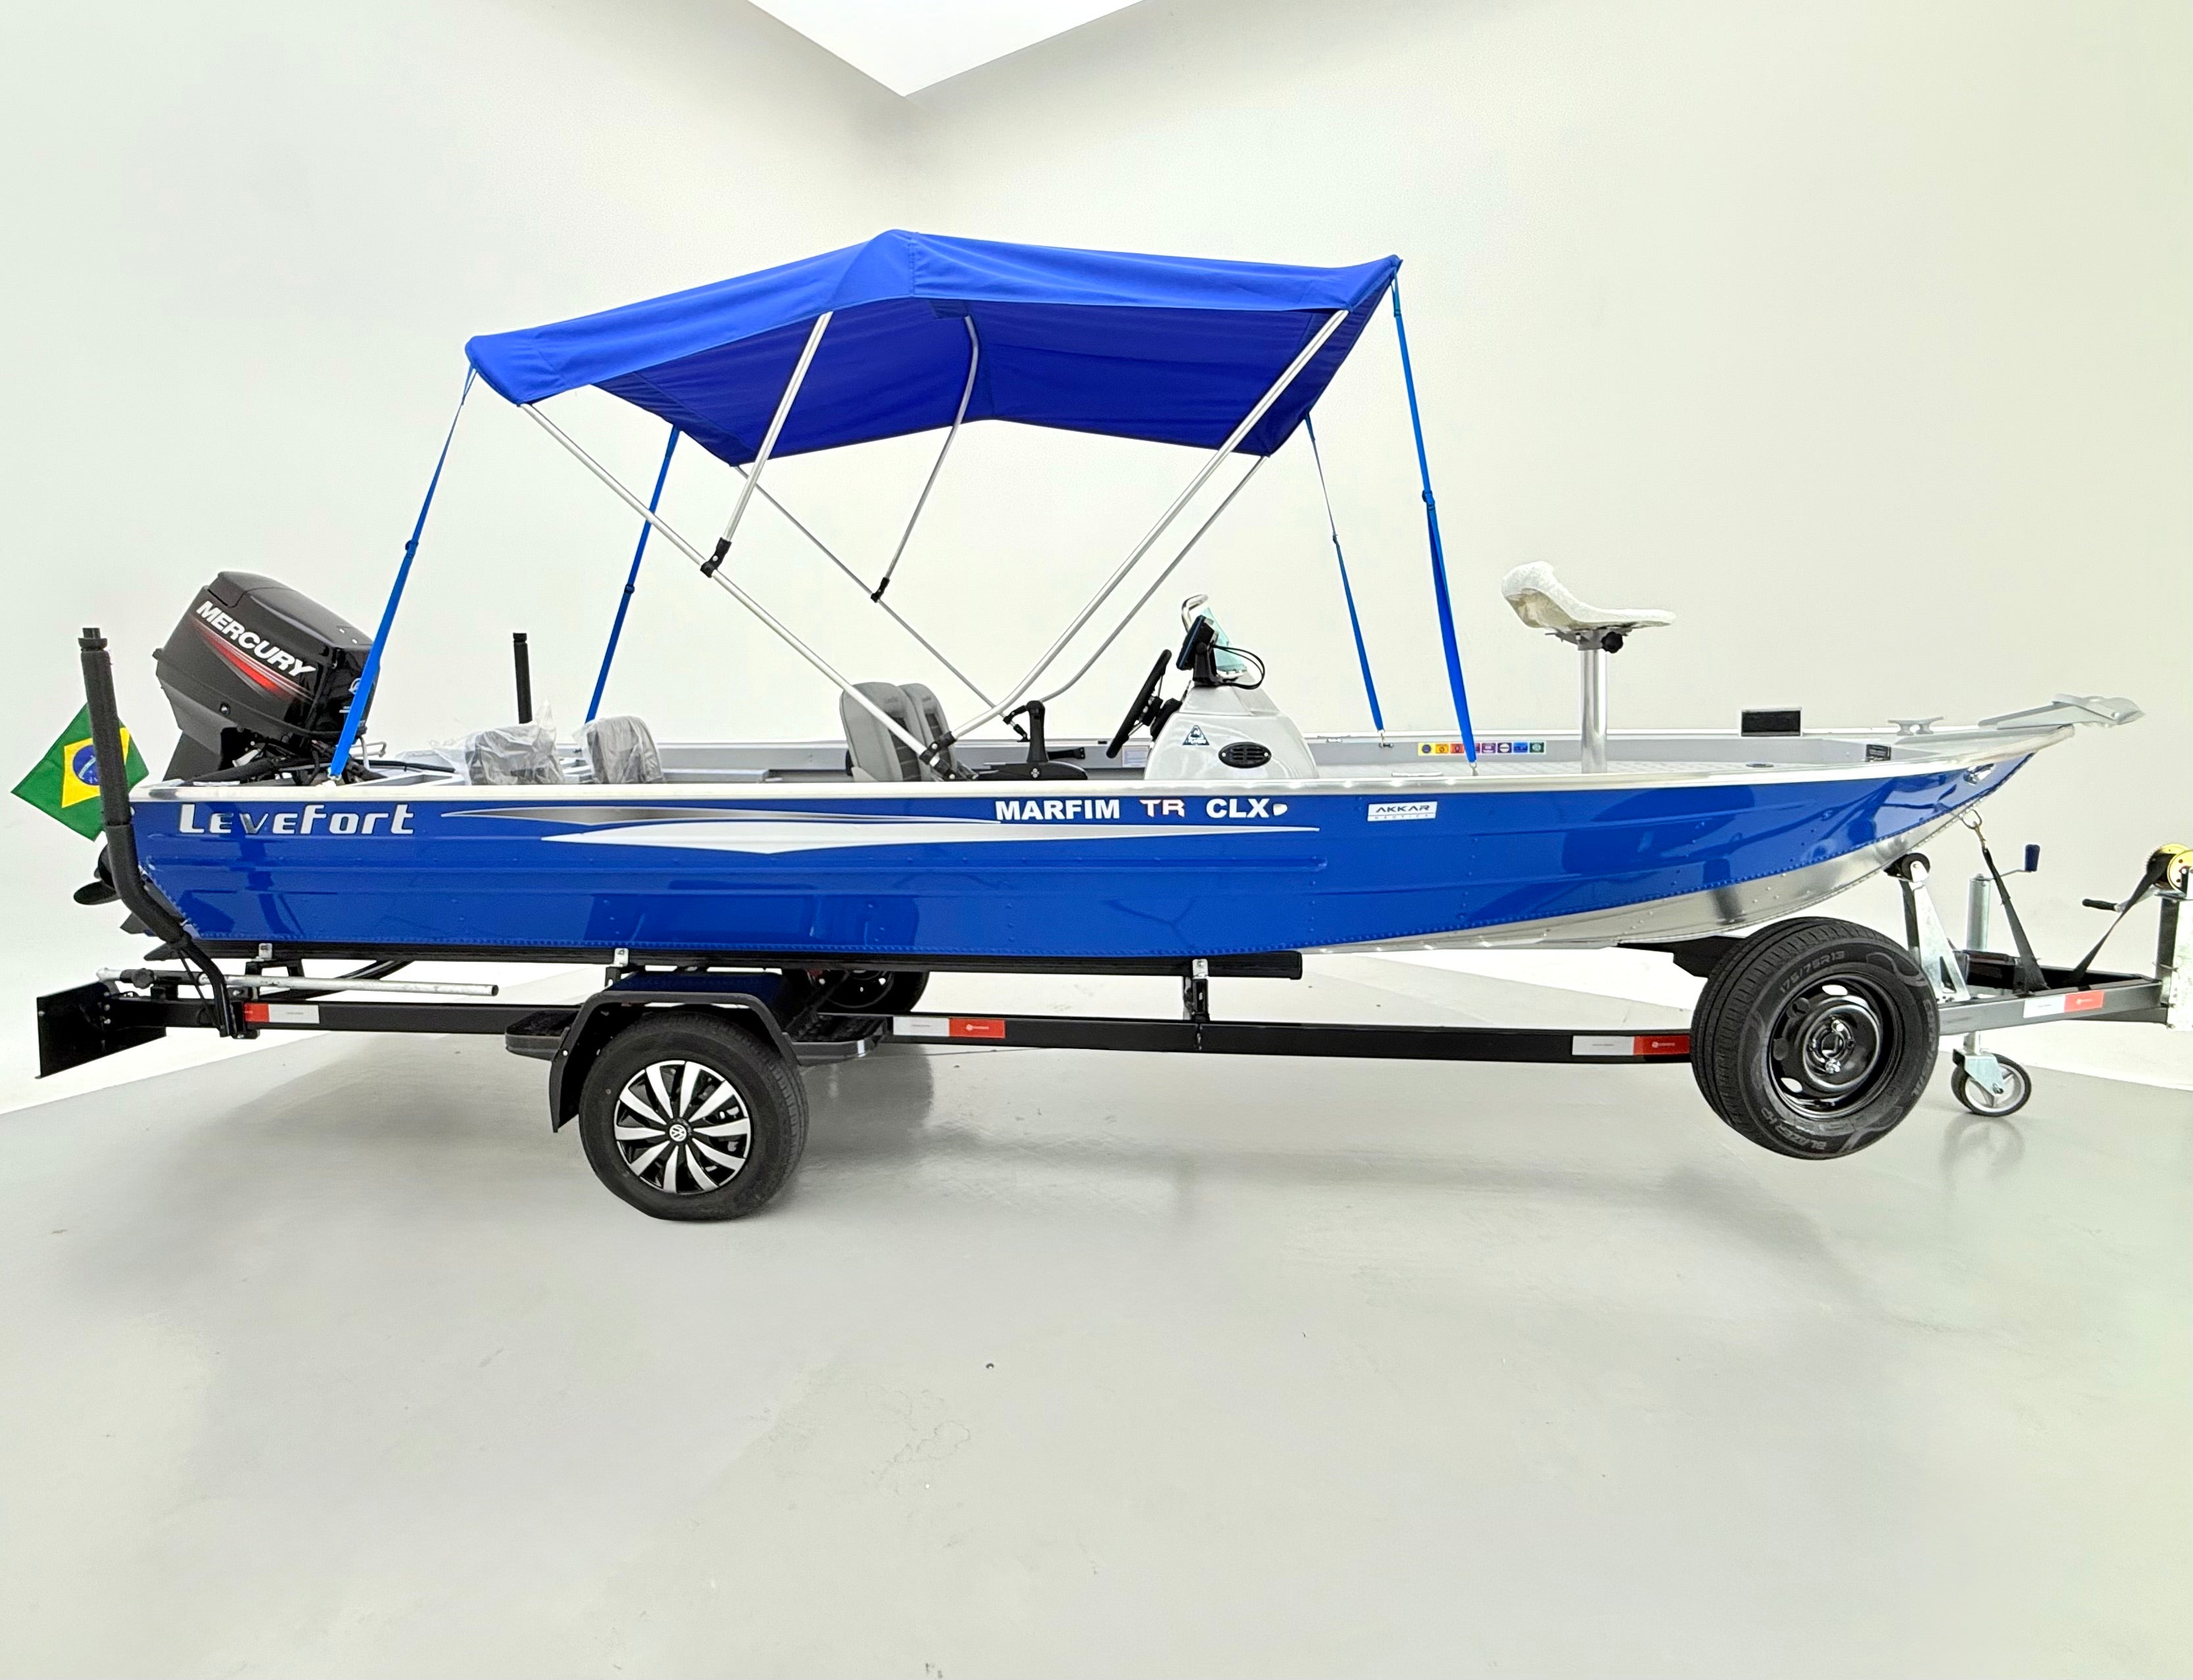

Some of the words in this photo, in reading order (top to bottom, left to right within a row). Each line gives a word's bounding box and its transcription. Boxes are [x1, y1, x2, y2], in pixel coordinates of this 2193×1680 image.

[196, 600, 316, 677] MERCURY
[995, 800, 1120, 821] MARFIM
[1139, 799, 1185, 817] TR
[1205, 798, 1269, 819] CLX
[1779, 951, 1844, 994] 175/75R13
[1775, 1123, 1827, 1149] BLAZER
